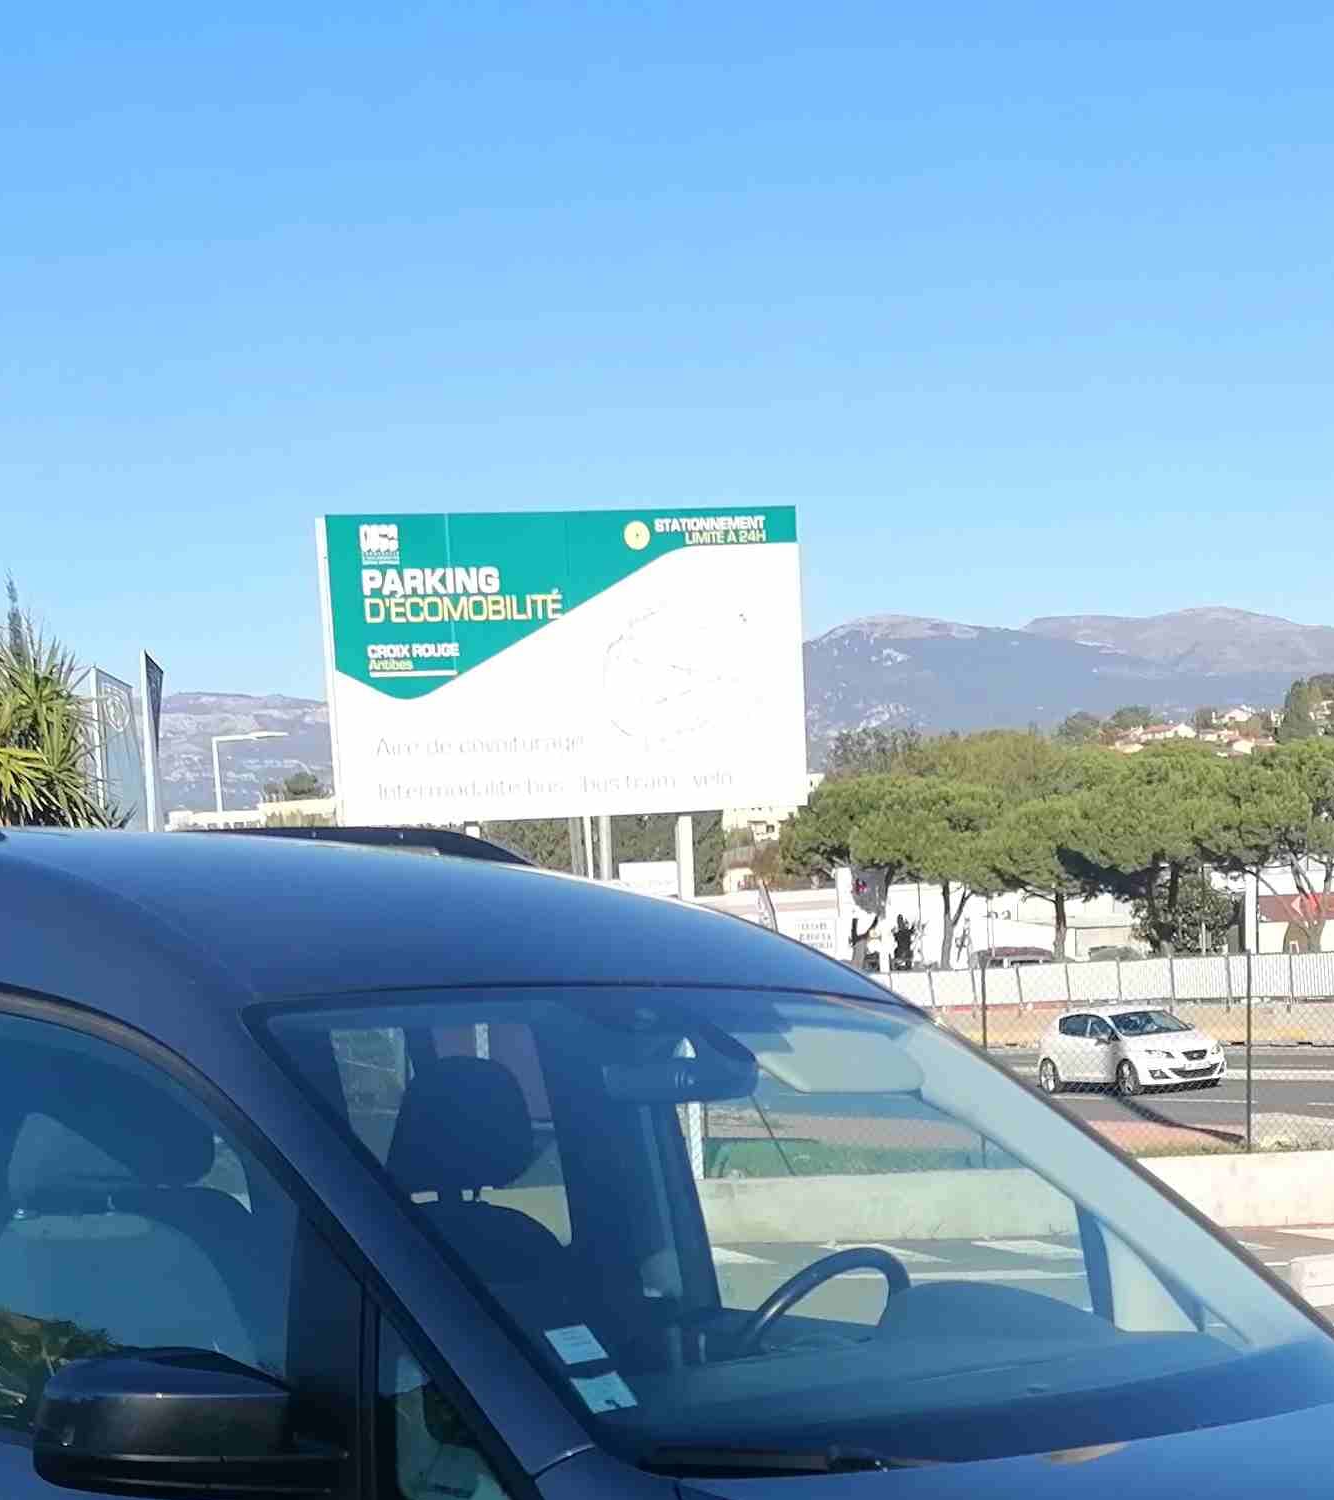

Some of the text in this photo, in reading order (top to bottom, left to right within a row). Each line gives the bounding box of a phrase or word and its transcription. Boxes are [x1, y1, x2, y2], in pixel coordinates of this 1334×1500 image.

[655, 515, 766, 533] STATIONNEMENT
[738, 529, 766, 543] 24H
[361, 566, 500, 595] PARKING
[364, 588, 564, 623] D'ÉCOMOBILITÉ
[367, 642, 460, 659] CROIX ROUGE
[369, 658, 414, 671] Antibes
